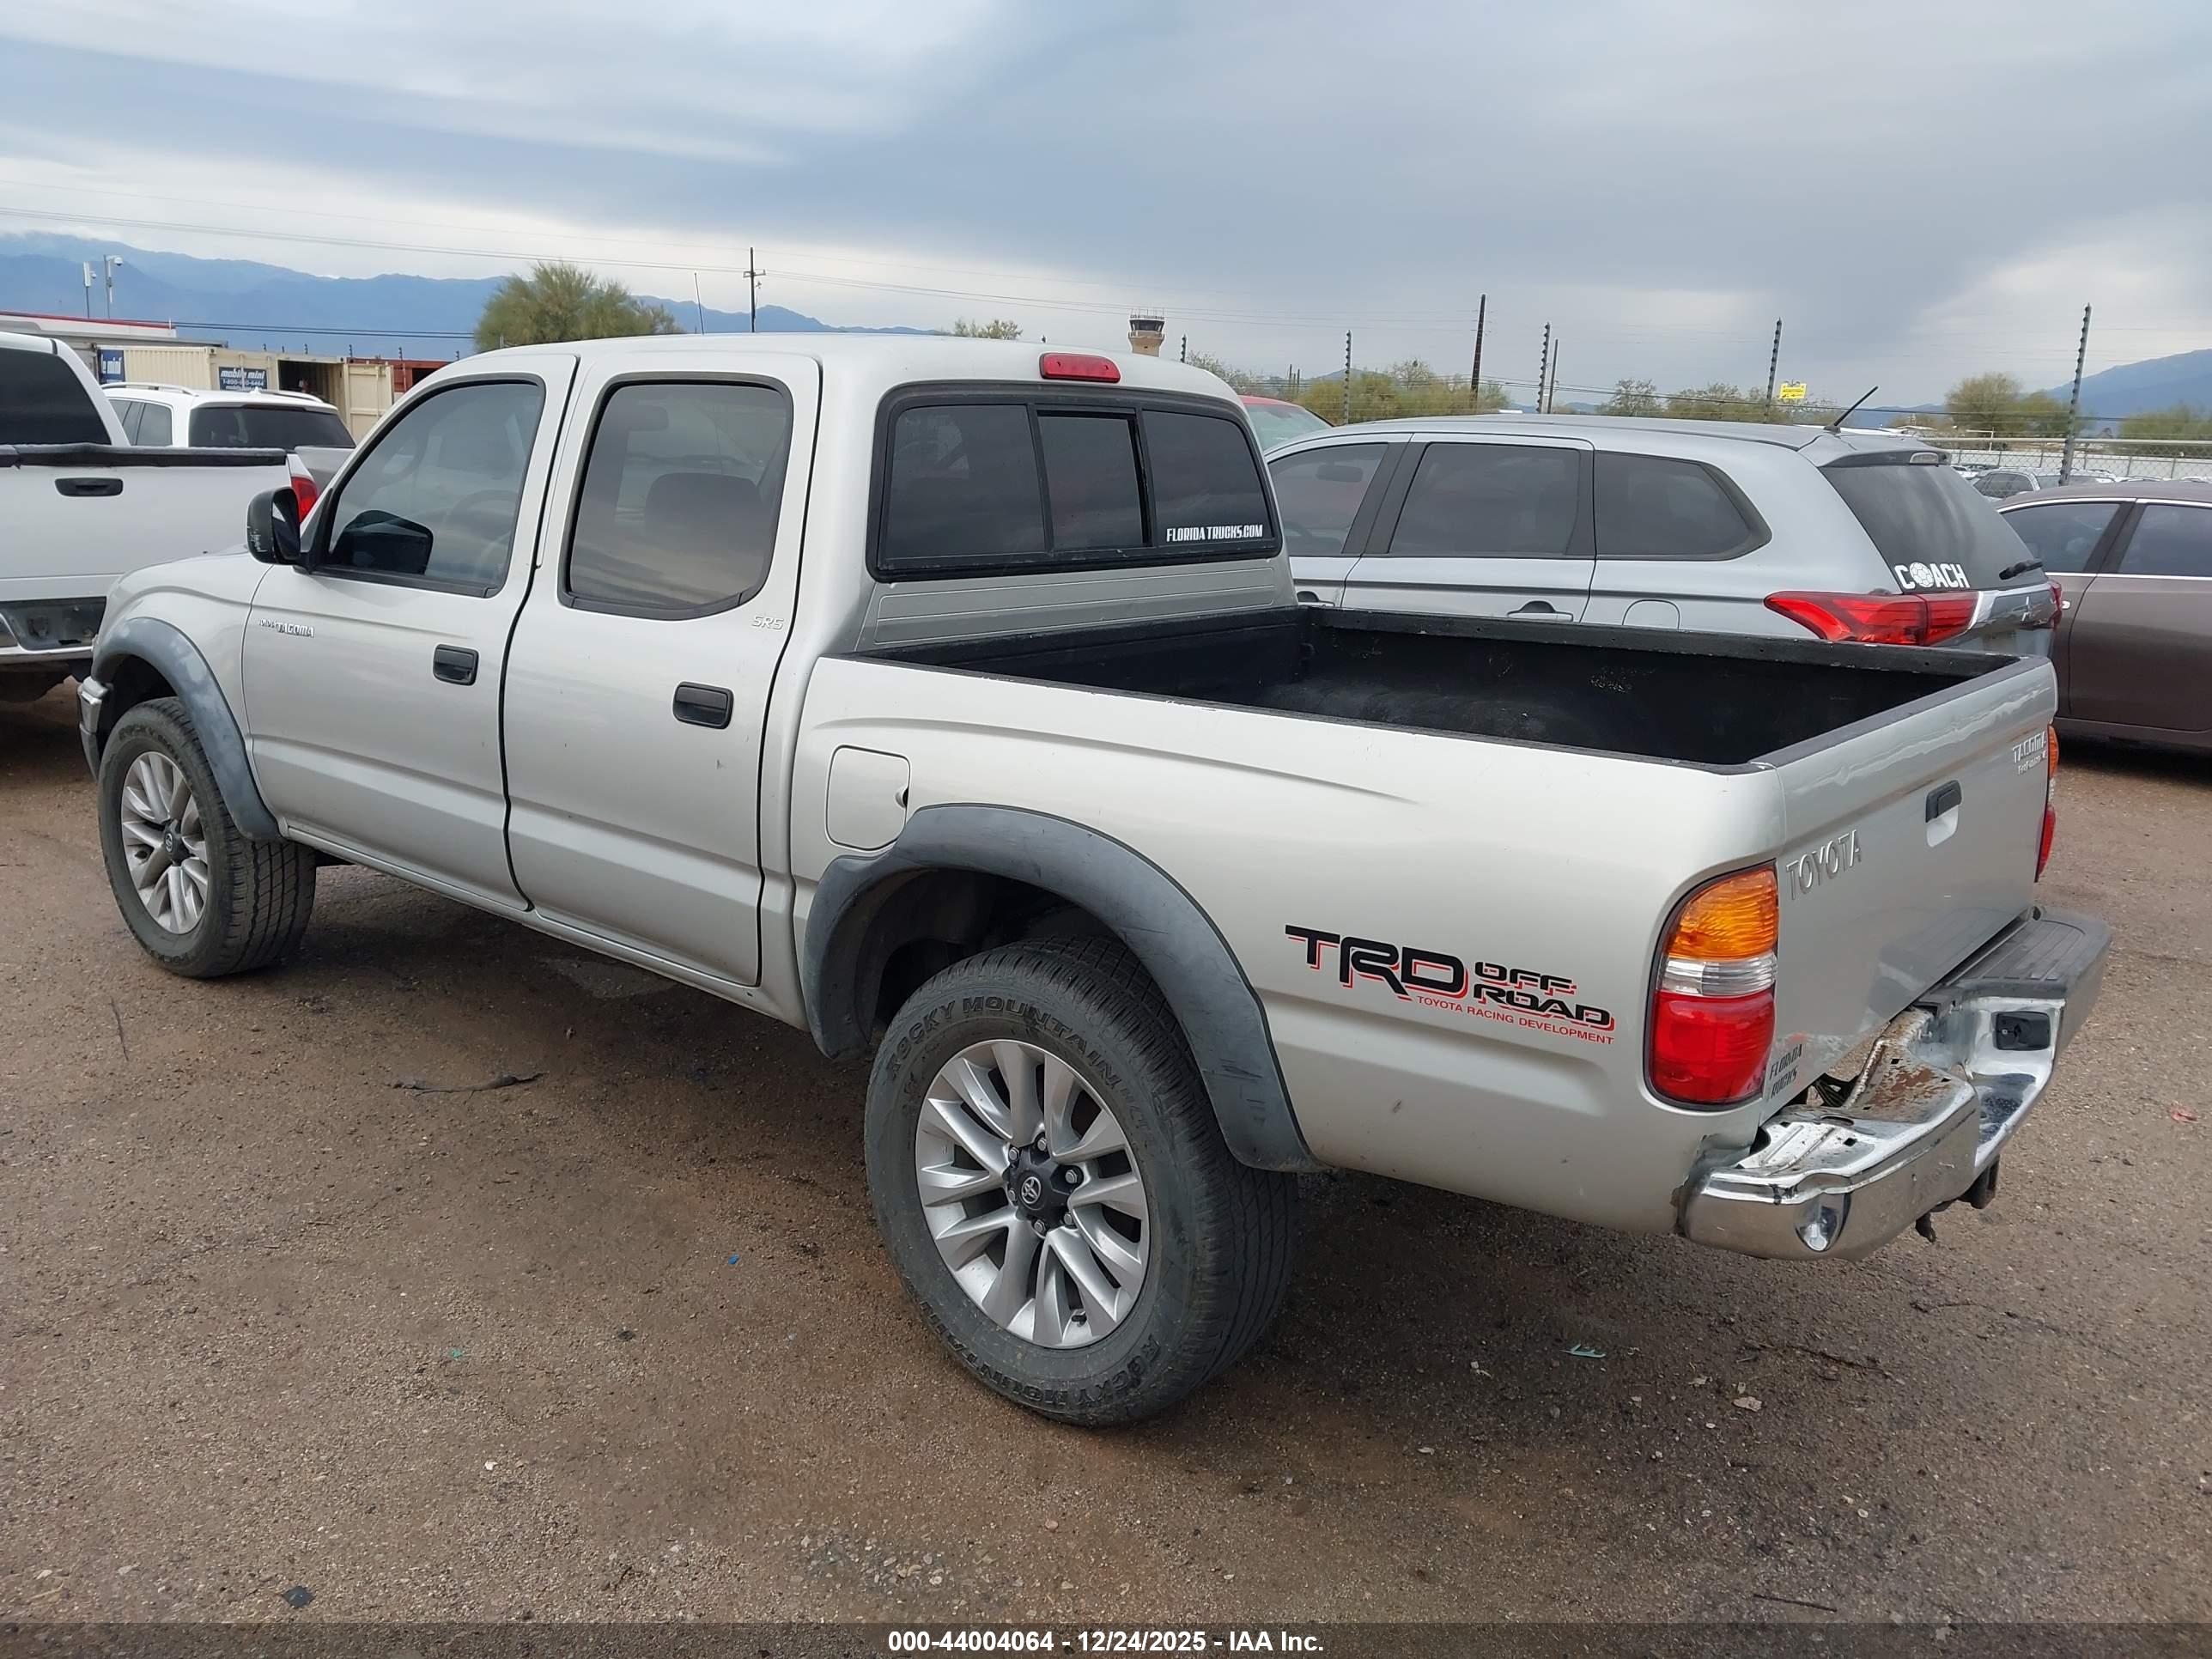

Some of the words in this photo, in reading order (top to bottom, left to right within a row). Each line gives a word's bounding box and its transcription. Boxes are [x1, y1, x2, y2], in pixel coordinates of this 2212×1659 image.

[247, 370, 265, 379] mini
[1166, 526, 1206, 542] FLORIDA
[1206, 524, 1263, 540] TRUCKS.COM
[276, 622, 314, 638] TACOMA
[751, 615, 785, 631] SRS
[2012, 731, 2047, 763] TACOMA
[1785, 830, 1862, 901] TOYOTA
[1285, 924, 1467, 1001] TRD
[1474, 961, 1577, 997] OFF
[1417, 995, 1463, 1013] TOYOTA
[1467, 1006, 1514, 1024] RACING
[1518, 1017, 1614, 1045] DEVELOPMENT
[1473, 983, 1615, 1031] ROAD
[888, 1000, 956, 1081] ROCKY
[963, 995, 1121, 1086] MOUNTAIN
